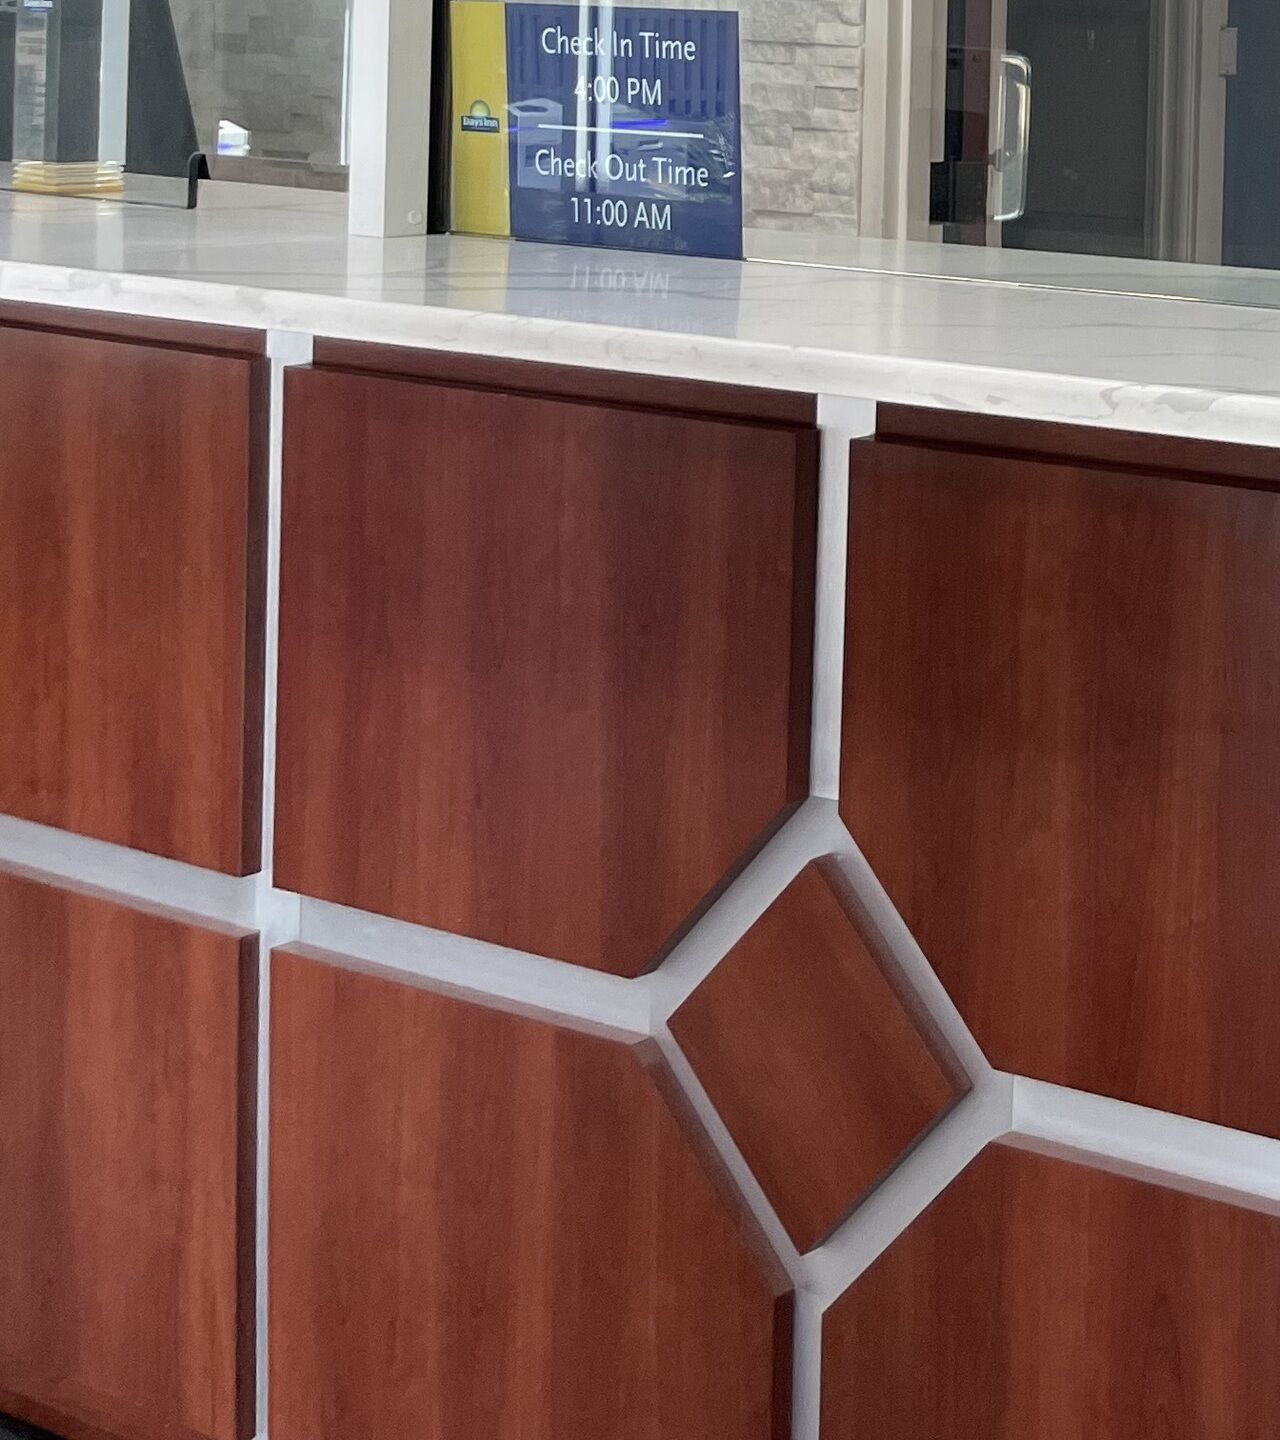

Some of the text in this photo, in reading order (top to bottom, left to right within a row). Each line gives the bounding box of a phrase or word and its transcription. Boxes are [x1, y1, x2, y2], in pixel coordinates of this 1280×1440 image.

[541, 26, 696, 61] Check In Time
[574, 76, 662, 106] 4:00 PM
[535, 147, 709, 187] Check Out Time
[571, 197, 671, 231] 11:00 AM
